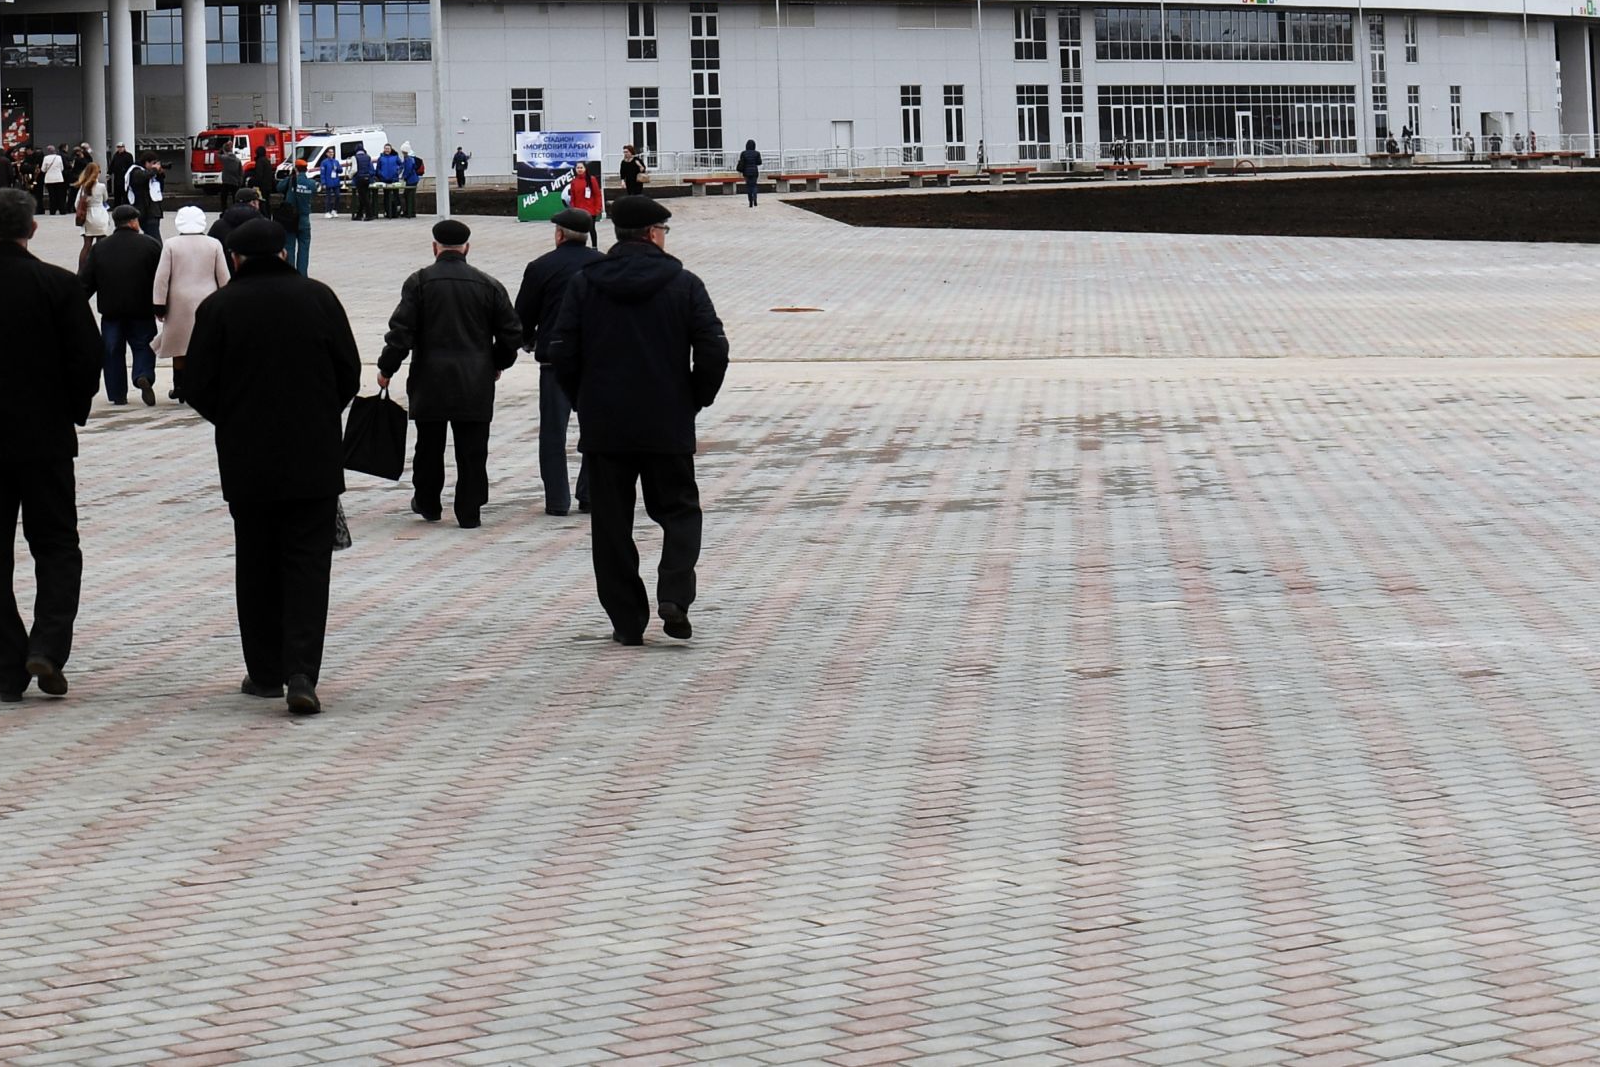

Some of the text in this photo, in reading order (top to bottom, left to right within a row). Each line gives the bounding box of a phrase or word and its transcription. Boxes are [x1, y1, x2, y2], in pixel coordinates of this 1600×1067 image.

[565, 151, 588, 159] МАТЧИ
[522, 168, 576, 208] МЫ В ИГРЕ!
